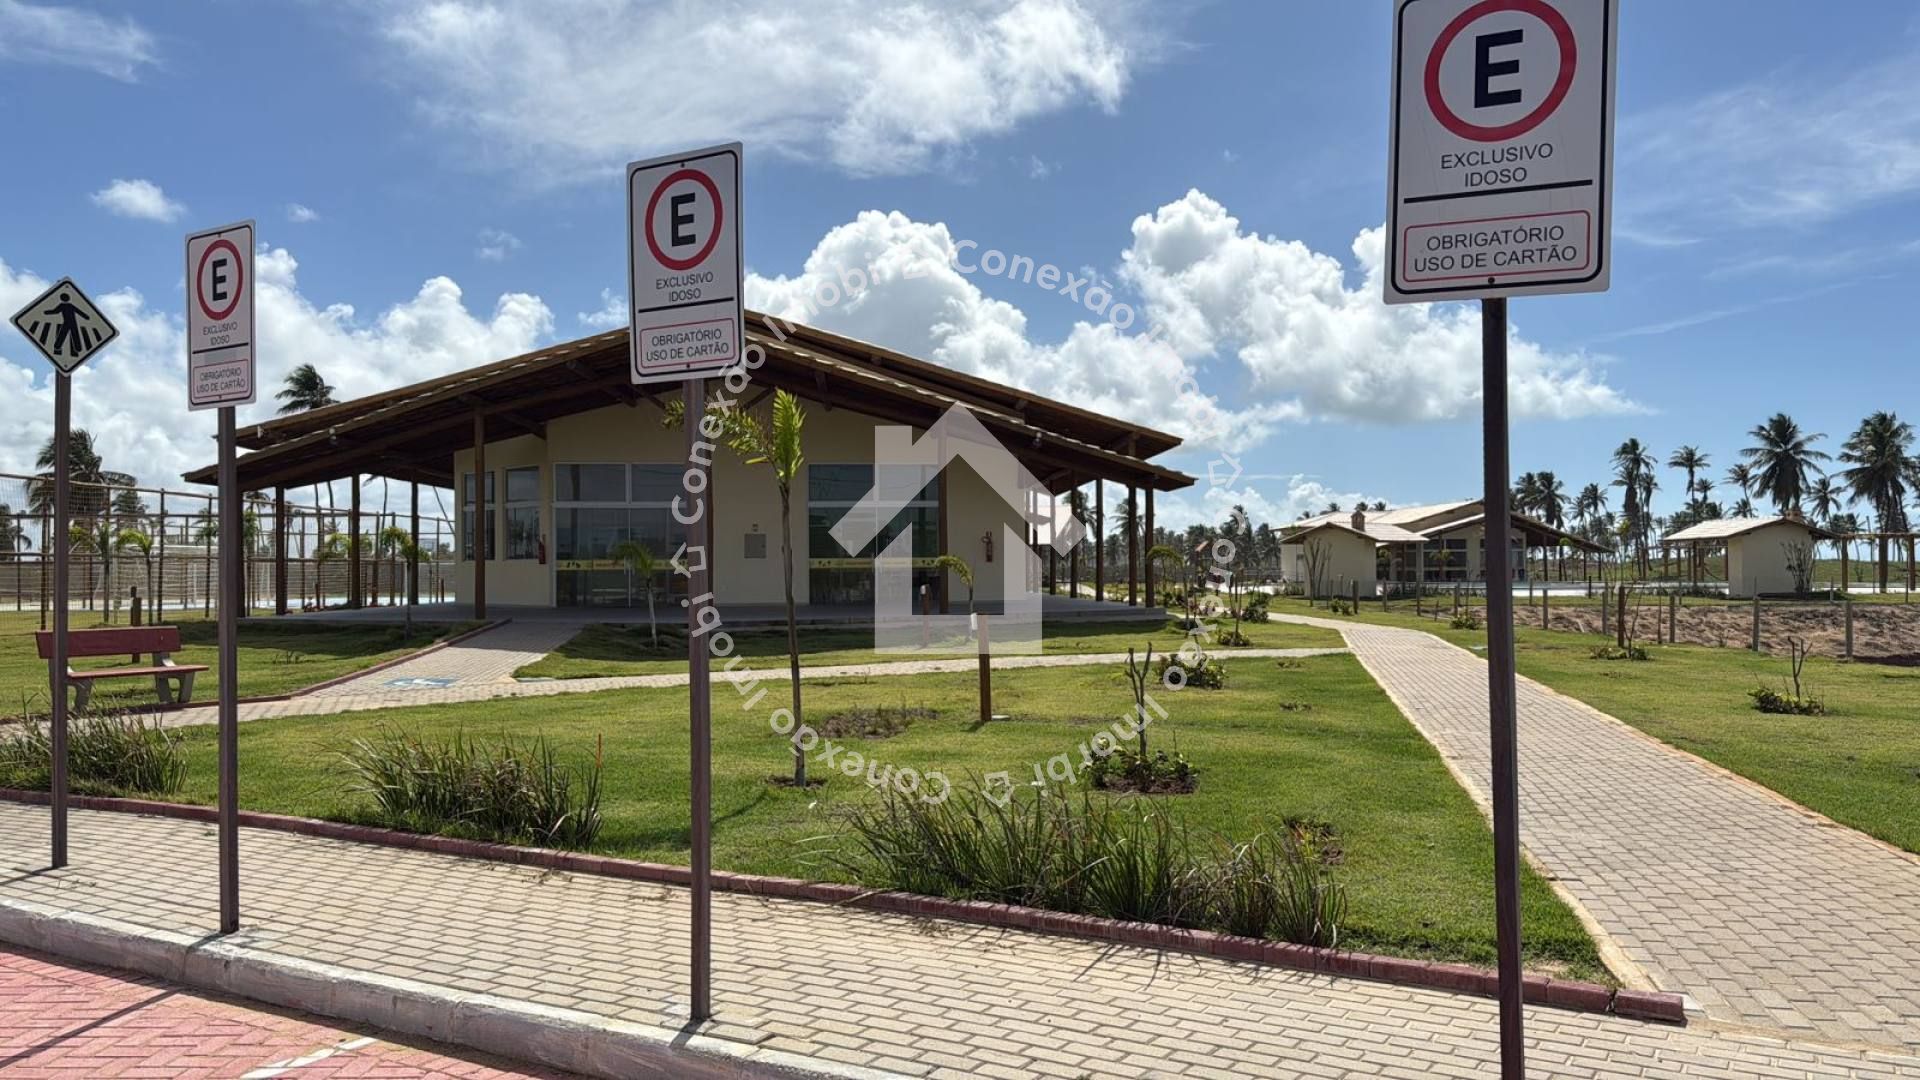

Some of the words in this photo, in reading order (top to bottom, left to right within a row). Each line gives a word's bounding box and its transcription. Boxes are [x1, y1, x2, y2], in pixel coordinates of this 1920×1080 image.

[1474, 29, 1523, 108] E
[1440, 143, 1553, 169] EXCLUSIVO
[1464, 167, 1528, 187] IDOSO
[671, 192, 696, 247] E
[1426, 225, 1564, 251] OBRIGATÓRIO
[1414, 255, 1454, 273] USO
[1461, 252, 1487, 269] DE
[1493, 245, 1577, 266] CARTÃO
[212, 258, 228, 301] E
[656, 271, 714, 290] EXCLUSIVO
[669, 288, 701, 302] IDOSO
[203, 321, 238, 336] EXCLUSIVO
[651, 328, 722, 347] OBRIGATÓRIO
[210, 334, 230, 346] IDOSO
[646, 348, 668, 362] USO
[670, 347, 684, 359] DE
[686, 341, 729, 358] CARTÃO
[200, 366, 242, 382] OBRIGATÓRIO
[196, 382, 210, 394] USO
[210, 380, 220, 392] DE
